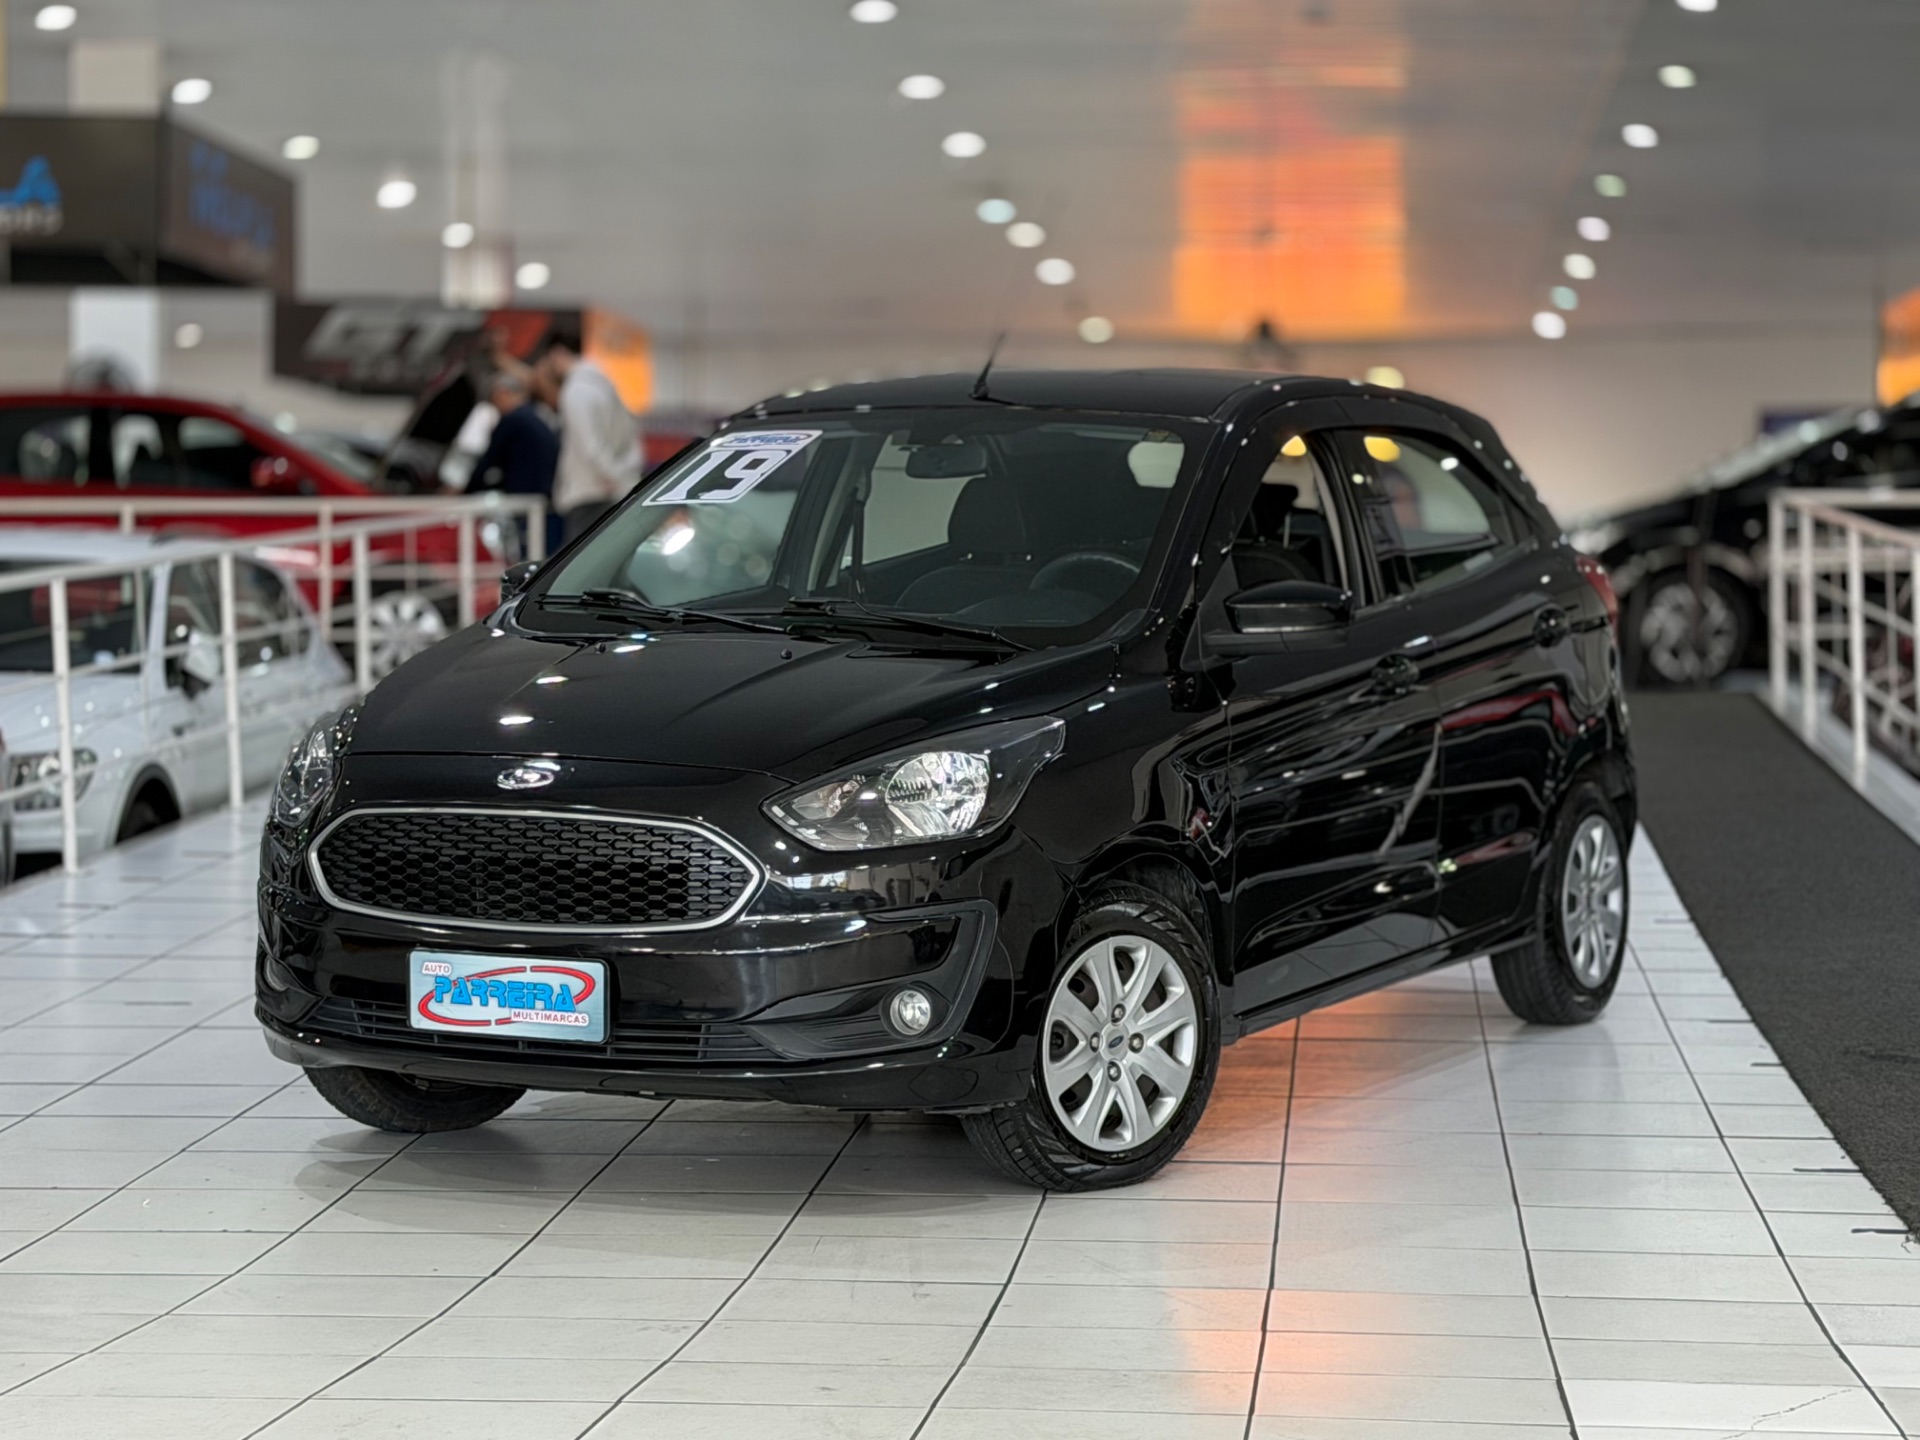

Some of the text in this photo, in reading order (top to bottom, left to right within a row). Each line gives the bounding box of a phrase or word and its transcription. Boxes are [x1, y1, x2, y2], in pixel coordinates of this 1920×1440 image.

[656, 450, 789, 501] 19
[423, 963, 450, 974] AUTO
[434, 976, 576, 1012] PARREIRA
[512, 1010, 588, 1024] MULTIMARCAS
